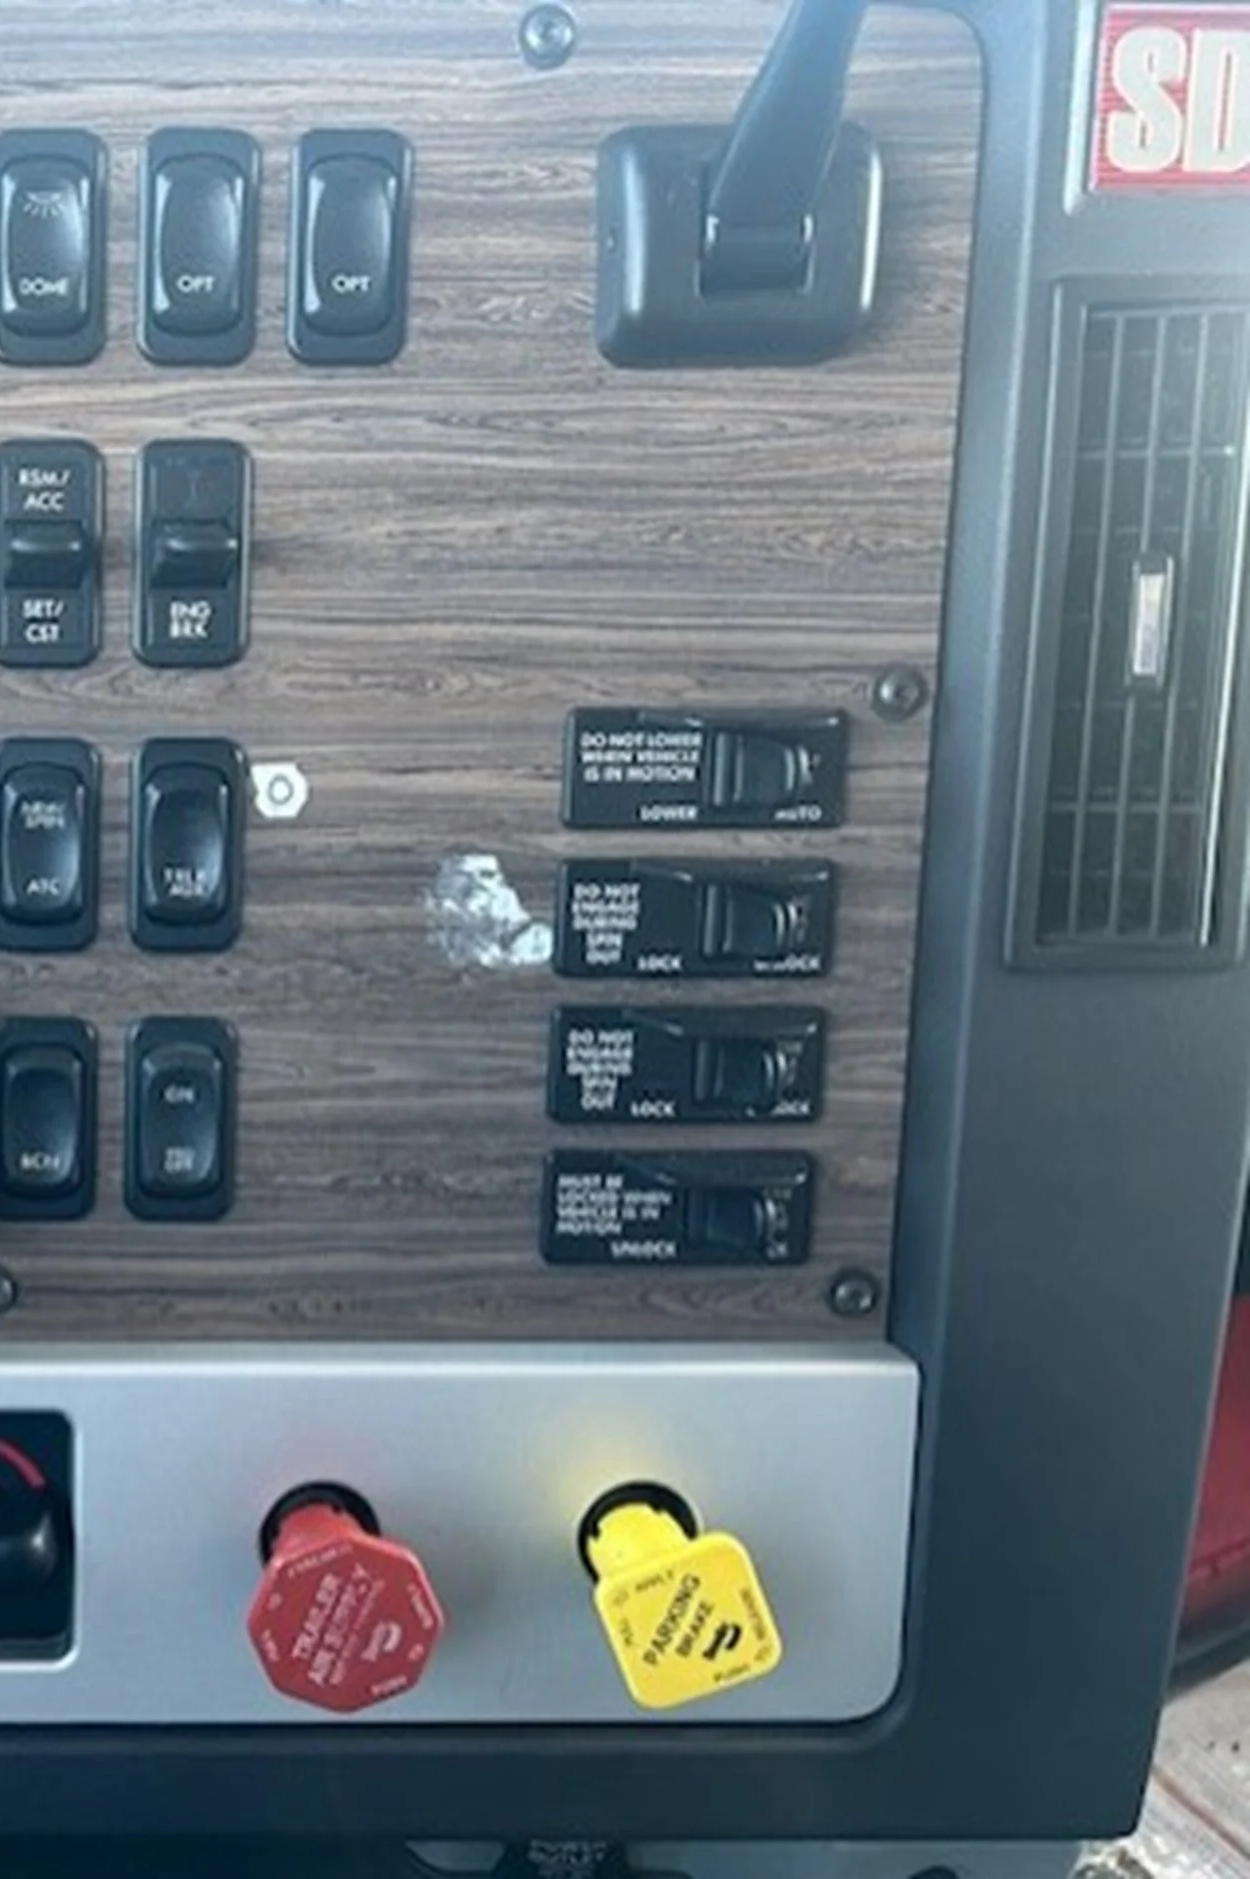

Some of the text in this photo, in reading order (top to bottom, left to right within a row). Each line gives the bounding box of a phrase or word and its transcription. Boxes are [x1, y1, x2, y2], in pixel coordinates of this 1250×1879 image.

[19, 277, 68, 297] DOME
[176, 274, 215, 293] OPT
[332, 274, 372, 293] OPT
[18, 468, 70, 488] RSM/
[24, 492, 66, 512] ACC
[24, 625, 62, 644] CST
[580, 731, 702, 748] DO NOT LOWER
[580, 749, 701, 765] WHEN VEHICLE
[583, 765, 697, 783] IS IN MOTION
[639, 804, 698, 821] LOWER
[26, 879, 61, 896] ATC
[637, 953, 683, 973] LOCK
[630, 1099, 676, 1118] LOCK
[641, 1570, 702, 1667] PARKING
[674, 1599, 714, 1658] BRAKE
